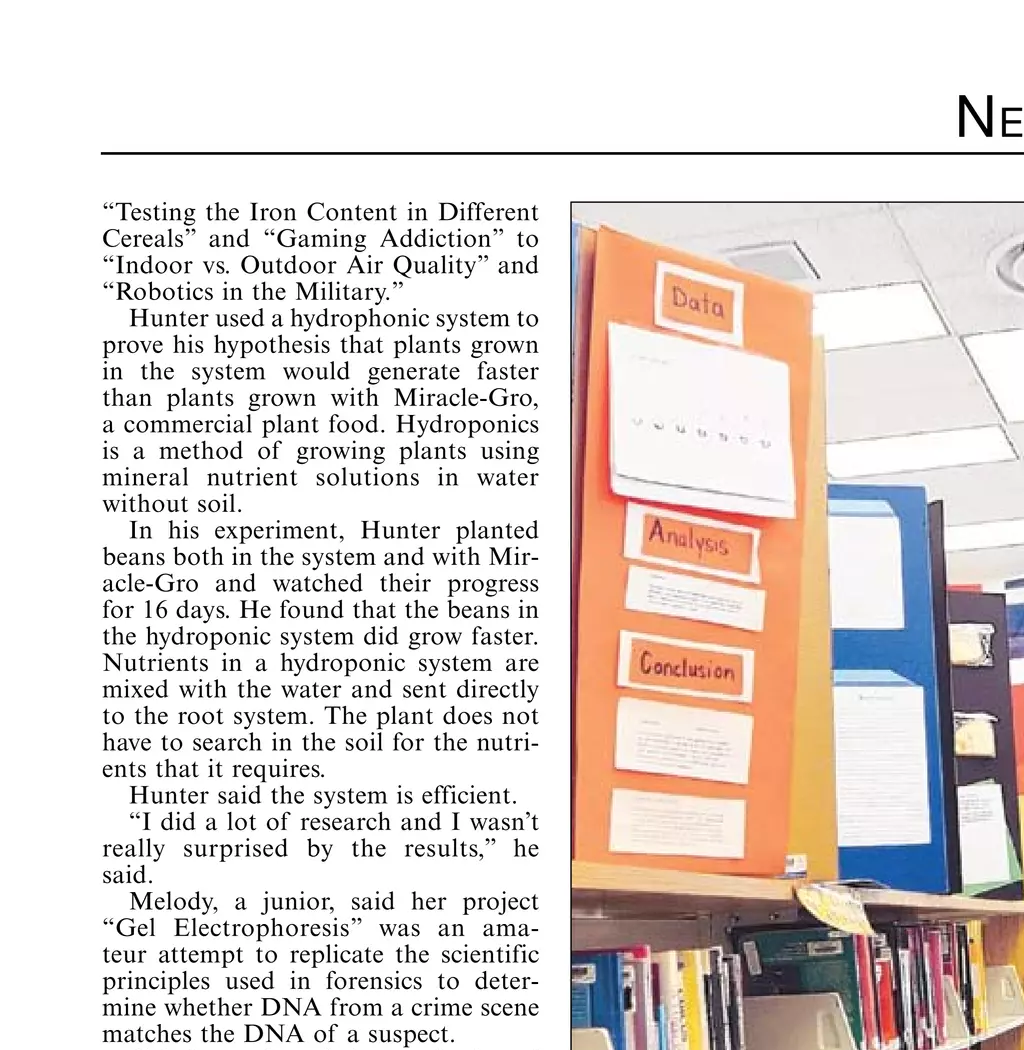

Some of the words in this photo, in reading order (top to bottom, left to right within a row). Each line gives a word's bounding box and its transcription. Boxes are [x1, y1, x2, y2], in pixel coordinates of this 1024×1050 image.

[103, 202, 196, 226] “Testing
[206, 202, 239, 221] the
[250, 203, 296, 221] Iron
[307, 202, 397, 221] Content
[408, 202, 427, 221] in
[439, 202, 539, 221] Different
[103, 228, 196, 247] Cereals”
[209, 229, 249, 247] and
[264, 228, 366, 252] “Gaming
[380, 228, 503, 247] Addiction”
[517, 231, 538, 247] to
[672, 285, 725, 318] Data
[130, 521, 152, 539] In
[169, 520, 199, 539] his
[215, 520, 344, 544] experiment,
[361, 521, 440, 539] Hunter
[456, 520, 538, 544] planted
[648, 518, 730, 558] Analysis
[640, 650, 736, 682] Conclusion
[103, 918, 155, 937] “Gel
[174, 917, 362, 942] Electrophoresis”
[379, 924, 420, 937] was
[438, 924, 464, 936] an
[483, 924, 538, 936] ama-
